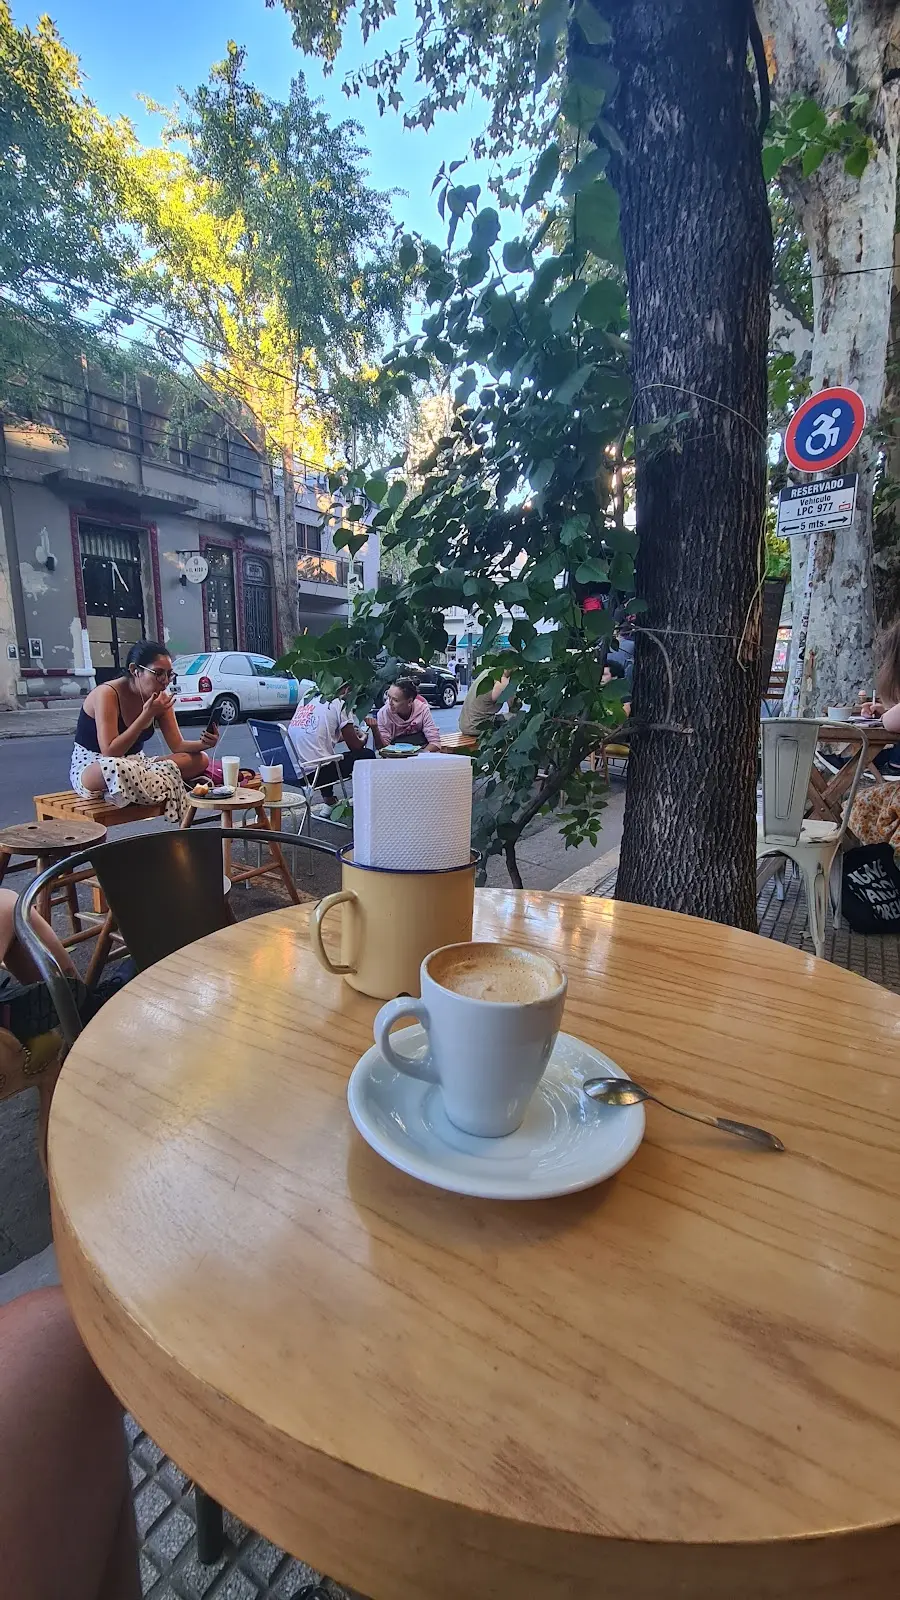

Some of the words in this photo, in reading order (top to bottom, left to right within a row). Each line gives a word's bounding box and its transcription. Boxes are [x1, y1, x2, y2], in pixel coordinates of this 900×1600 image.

[791, 479, 844, 498] RESERVADO
[797, 505, 813, 516] LPC
[817, 502, 833, 512] 977
[800, 523, 806, 531] 5
[808, 520, 827, 530] mts.
